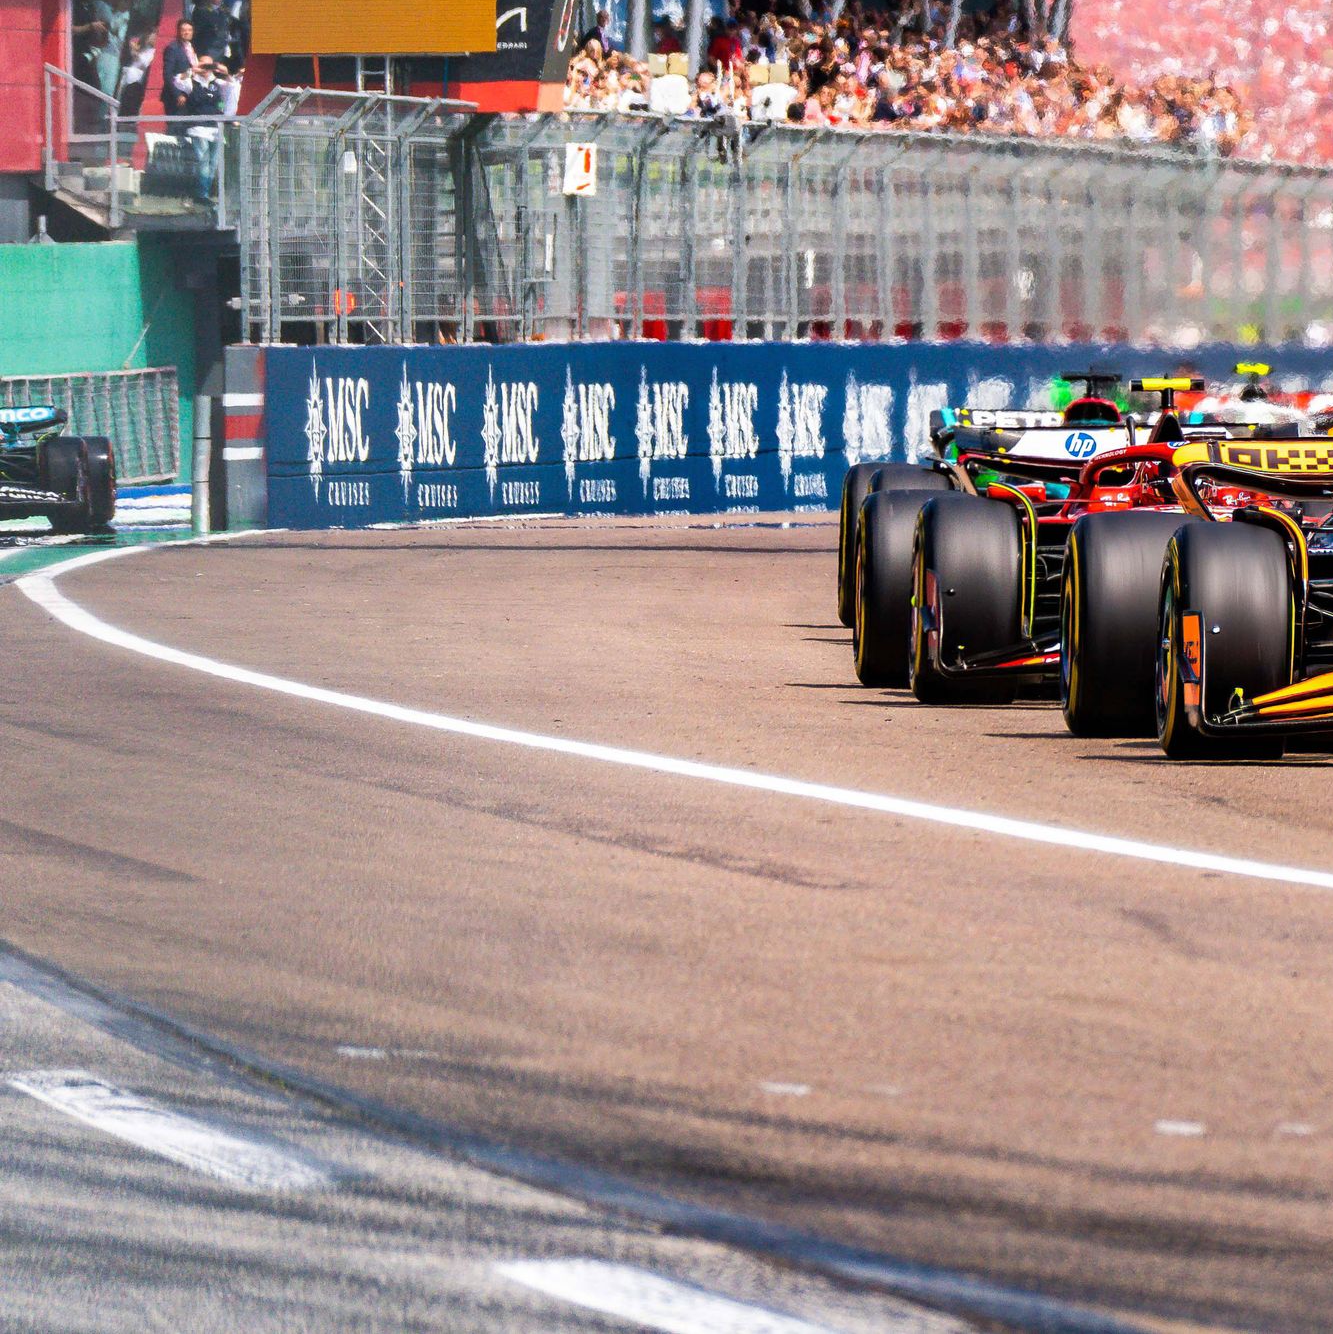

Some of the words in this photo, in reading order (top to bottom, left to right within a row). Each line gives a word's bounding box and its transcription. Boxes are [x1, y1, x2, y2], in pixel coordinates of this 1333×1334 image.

[326, 377, 369, 462] MSC
[416, 381, 456, 465] MSC
[501, 381, 540, 463] MSC
[1068, 433, 1097, 458] hp
[328, 482, 370, 506] CRUISES
[417, 483, 457, 508] CRUISES
